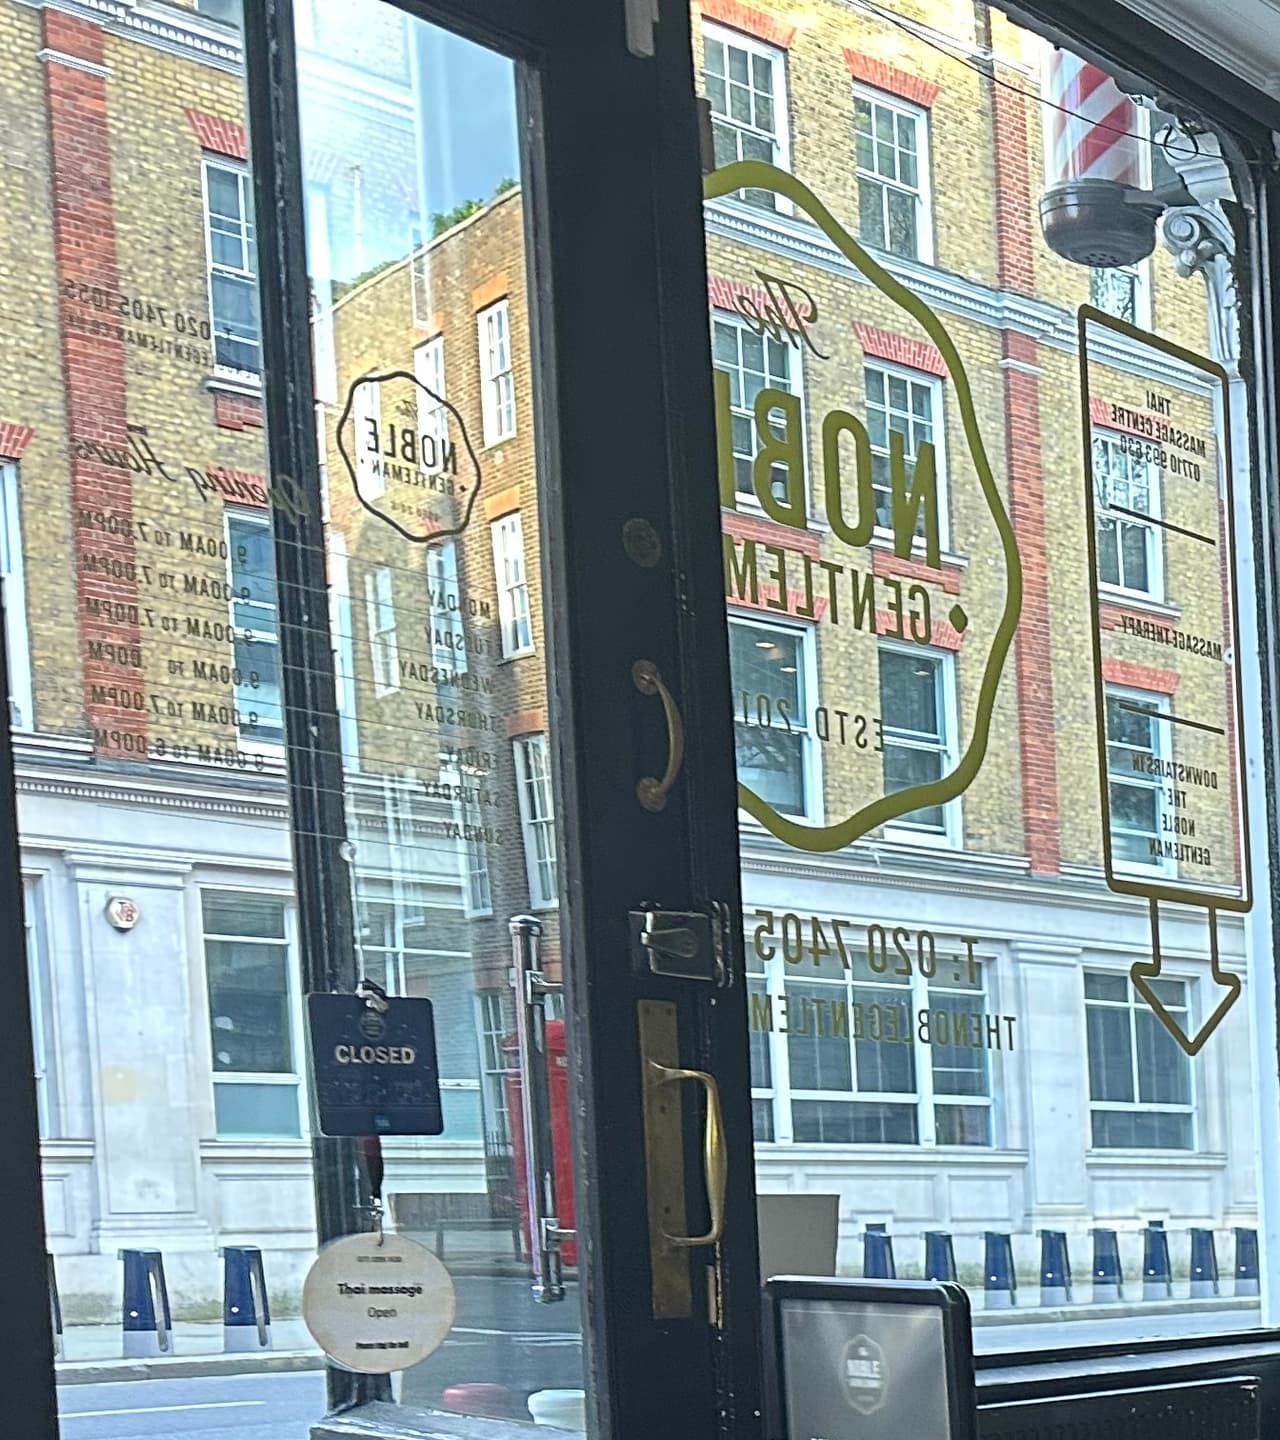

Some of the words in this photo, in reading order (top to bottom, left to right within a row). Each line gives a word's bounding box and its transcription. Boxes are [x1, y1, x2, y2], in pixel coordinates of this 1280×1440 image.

[334, 1044, 417, 1065] CLOSED
[337, 1282, 366, 1296] Thai
[368, 1285, 424, 1298] massage
